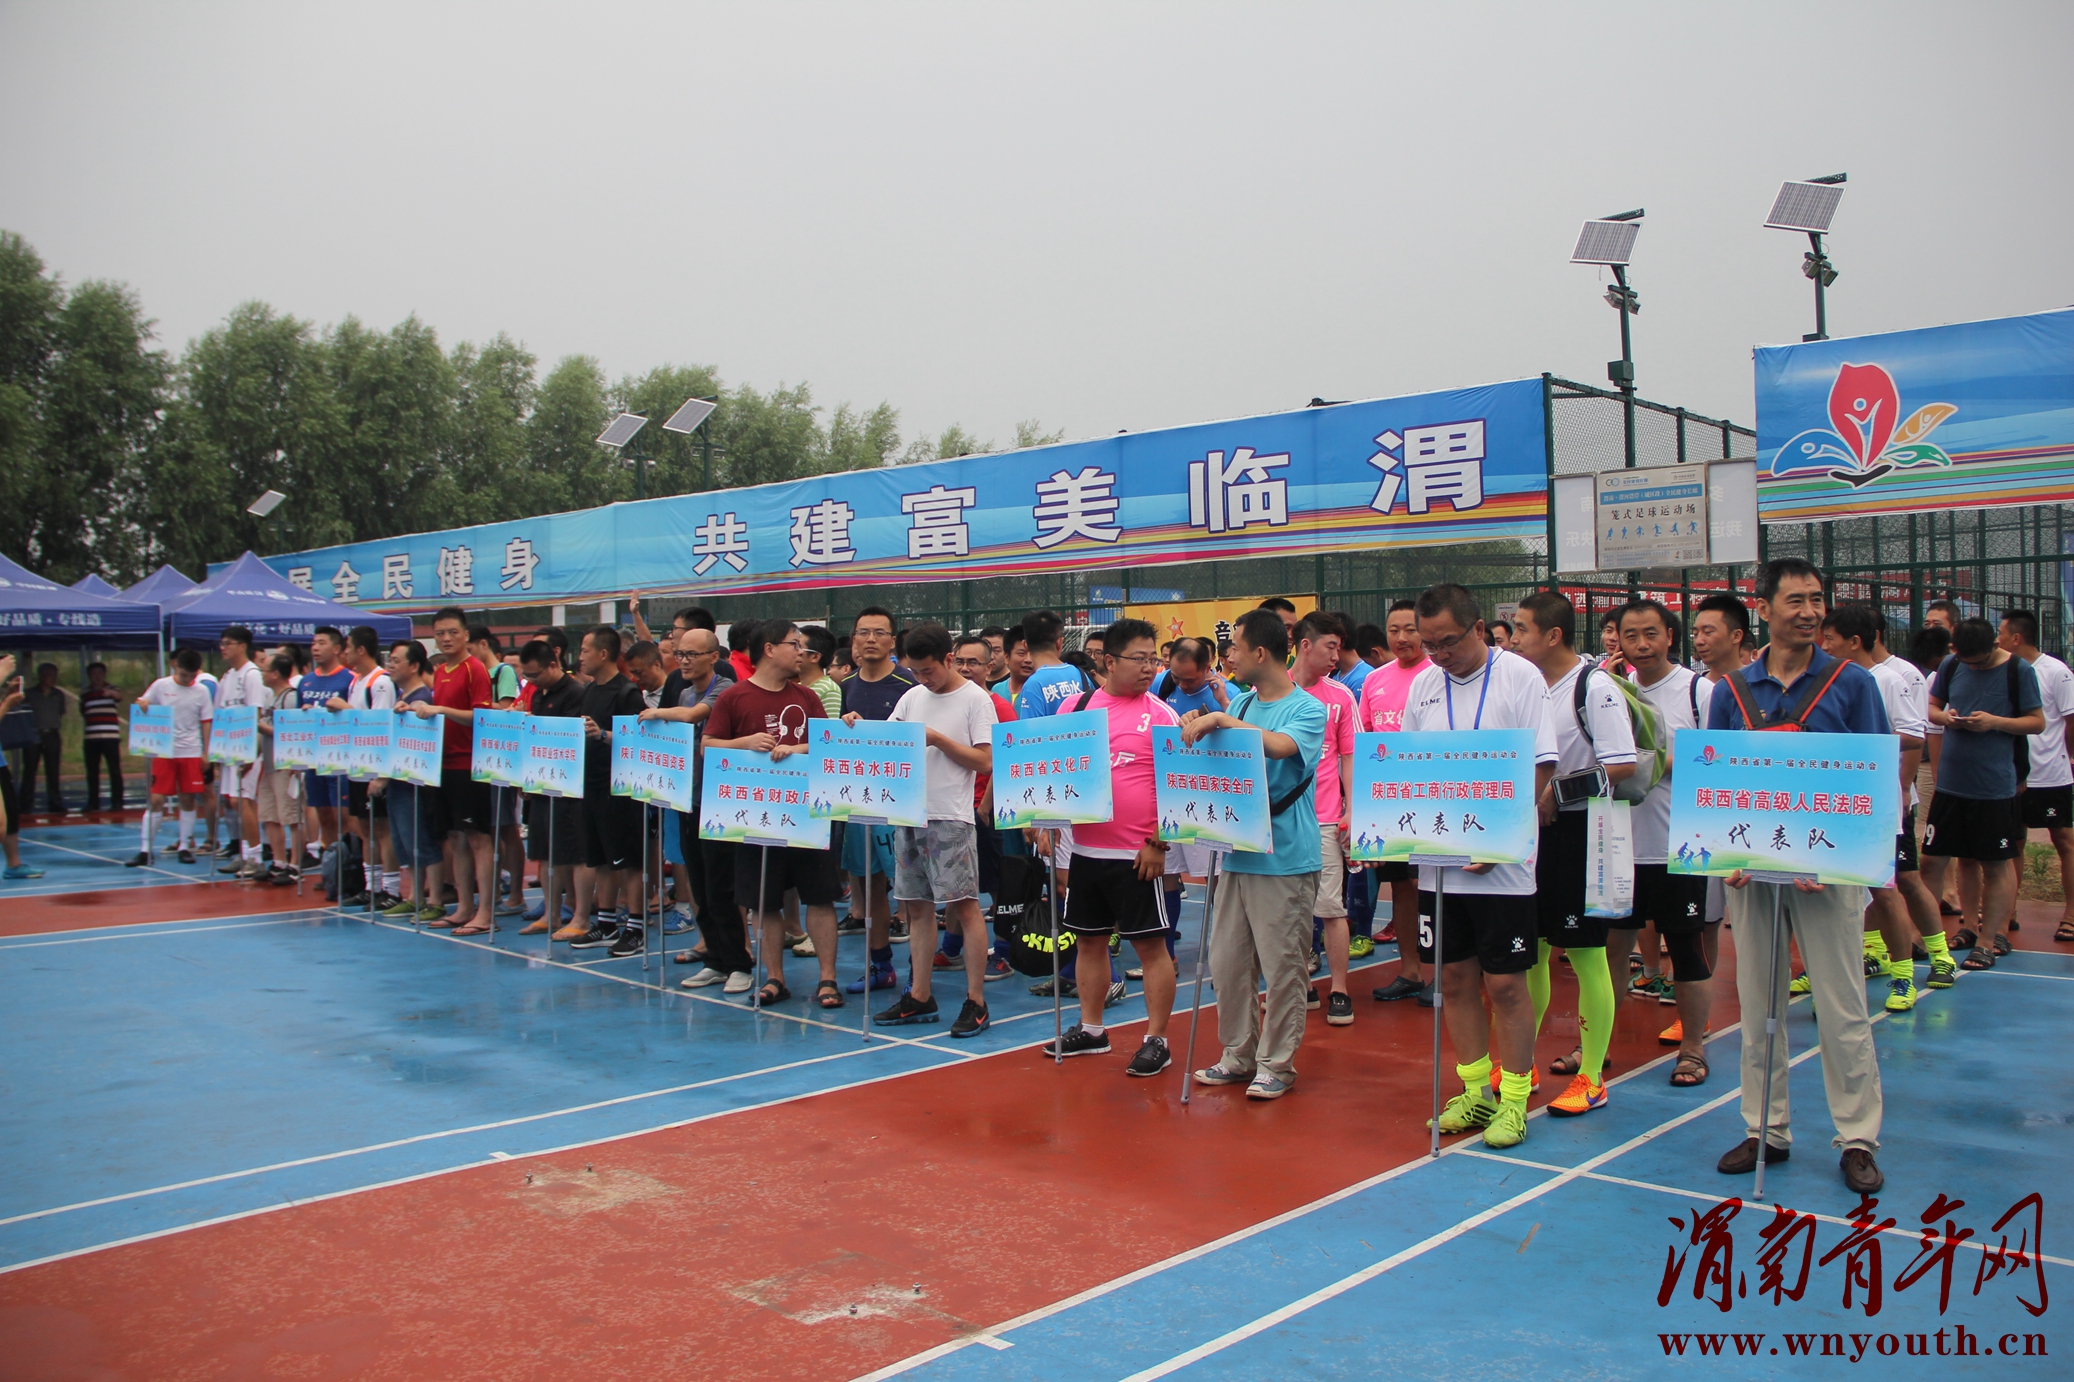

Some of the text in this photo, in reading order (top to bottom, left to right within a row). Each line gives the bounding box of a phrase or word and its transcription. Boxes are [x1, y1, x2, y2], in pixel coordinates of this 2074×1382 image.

[692, 417, 1487, 576] 共建富美临渭
[1611, 503, 1696, 520] 笼式足球运动场
[1137, 713, 1151, 733] 3
[480, 738, 519, 752] 陕西省人社厅
[530, 746, 576, 762] 渭南职业技术学院
[639, 749, 685, 771] 陕西省国资委
[1398, 750, 1518, 761] 陕西省第一届全民健身运动会
[1729, 756, 1878, 771] 陕西省第一届全民健身运动会
[823, 758, 912, 779] 陕西省水利厅
[1010, 755, 1091, 779] 陕西省文化厅
[647, 773, 676, 791] 代表队
[1166, 772, 1254, 796] 陕西省国家安全厅
[1371, 780, 1515, 800] 陕西省工商行政管理局
[839, 785, 896, 803] 代表队
[1023, 784, 1080, 806] 代表队
[1696, 787, 1873, 816] 陕西省高级人民法院
[735, 809, 797, 827] 代表队
[1186, 802, 1240, 823] 代表队
[1398, 811, 1485, 835] 代表队
[1728, 821, 1836, 850] 代表队
